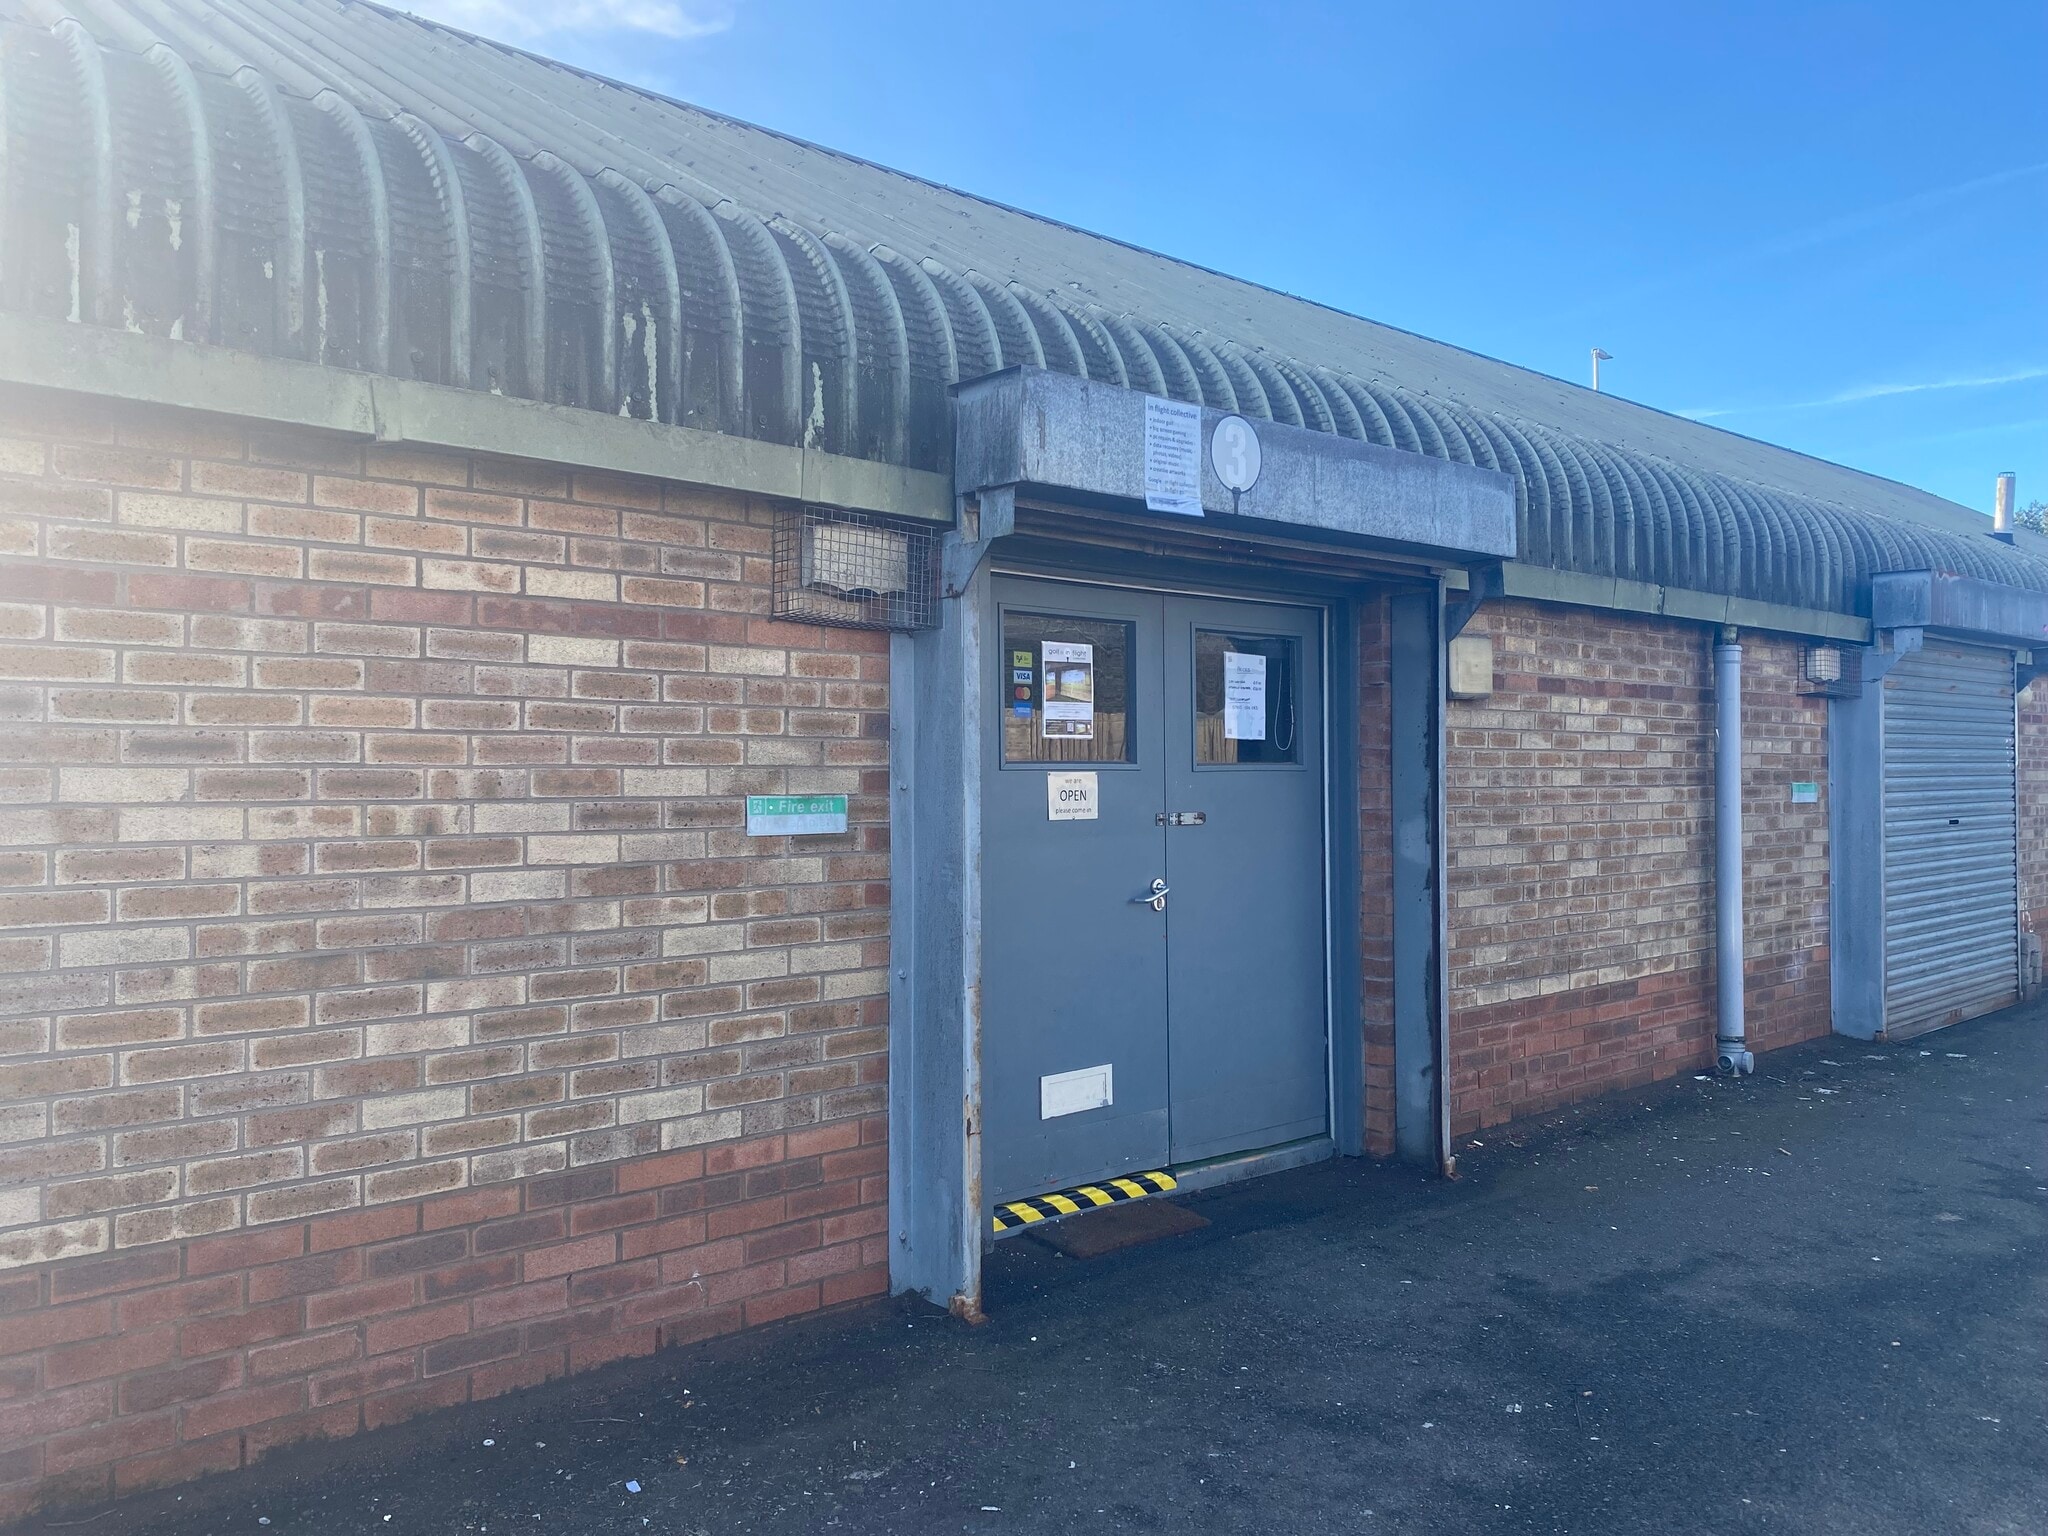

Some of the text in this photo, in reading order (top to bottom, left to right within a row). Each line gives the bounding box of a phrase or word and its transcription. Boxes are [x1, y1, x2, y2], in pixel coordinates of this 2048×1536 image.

[1155, 404, 1170, 415] flight
[1170, 408, 1197, 420] collective
[1225, 424, 1247, 485] 3
[1016, 672, 1031, 681] VISA
[1059, 789, 1087, 802] OPEN
[779, 800, 835, 813] Fire exit
[1055, 807, 1071, 815] please
